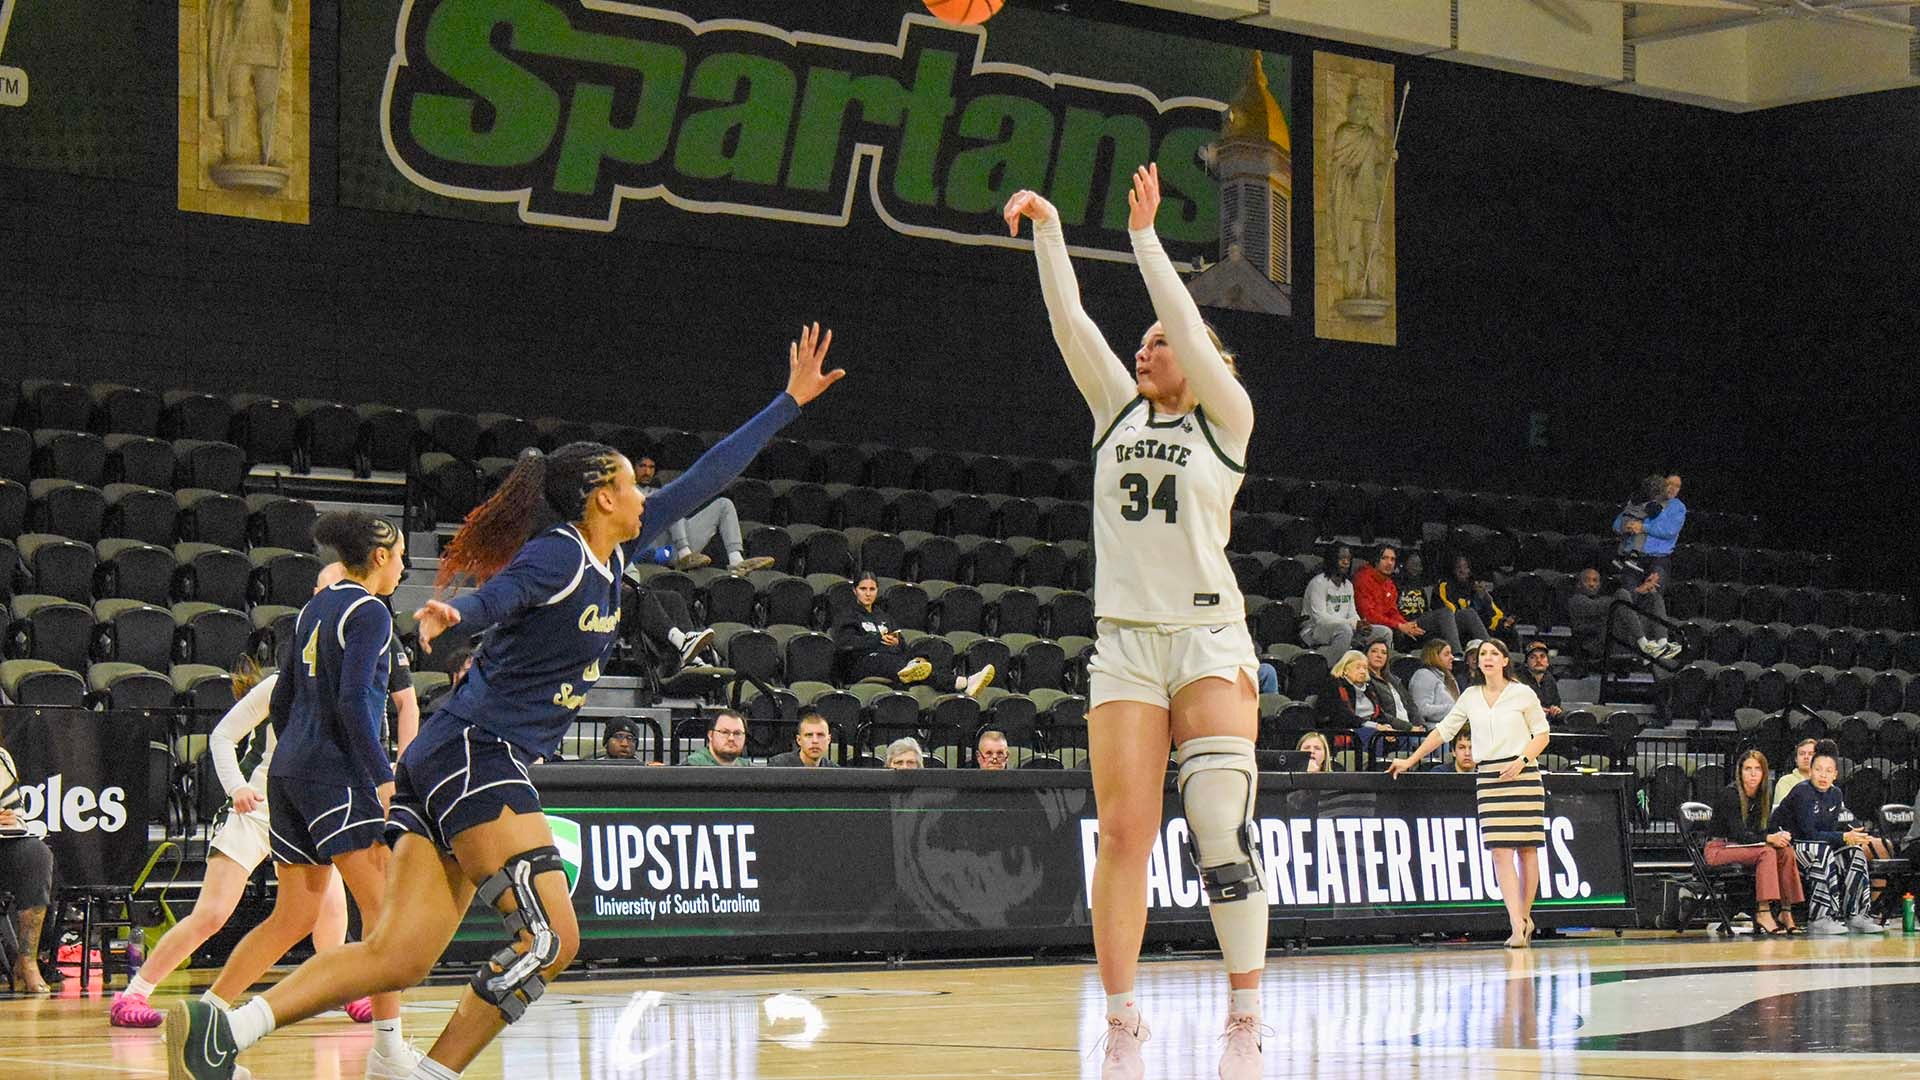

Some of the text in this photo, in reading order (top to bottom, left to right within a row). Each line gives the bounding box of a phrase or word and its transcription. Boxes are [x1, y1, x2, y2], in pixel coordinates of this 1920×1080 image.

[409, 0, 1221, 242] Spartans
[1115, 439, 1192, 467] UPSTATE
[1120, 473, 1178, 523] 34
[303, 620, 321, 677] 4
[591, 824, 759, 891] UPSTATE
[595, 892, 760, 921] University of South Carolina
